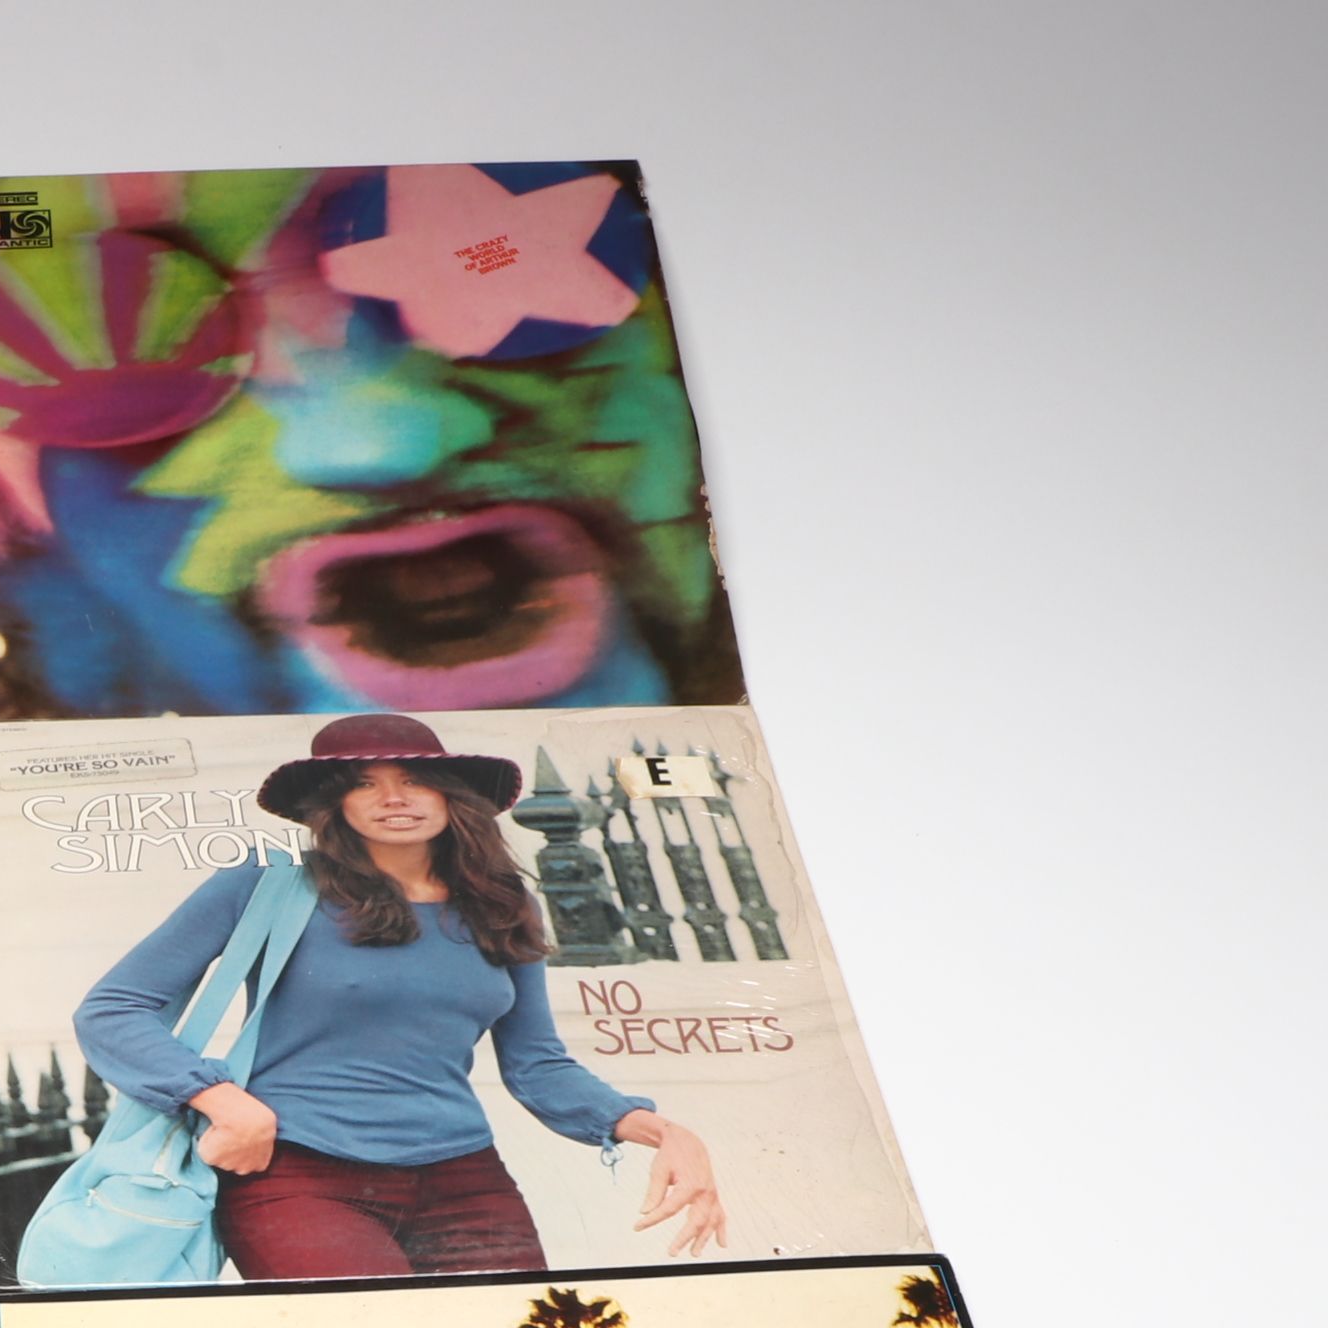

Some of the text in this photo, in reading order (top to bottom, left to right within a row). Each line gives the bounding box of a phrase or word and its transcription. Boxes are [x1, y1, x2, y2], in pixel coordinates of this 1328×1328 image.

[468, 245, 505, 260] WORLD
[478, 257, 517, 275] BROWN
[26, 756, 77, 764] FEATURES
[92, 759, 119, 770] SO
[645, 757, 672, 786] E
[21, 789, 257, 833] CARLY
[51, 827, 305, 873] SIMON
[577, 980, 642, 1015] NO
[593, 1016, 794, 1056] SECRETS
